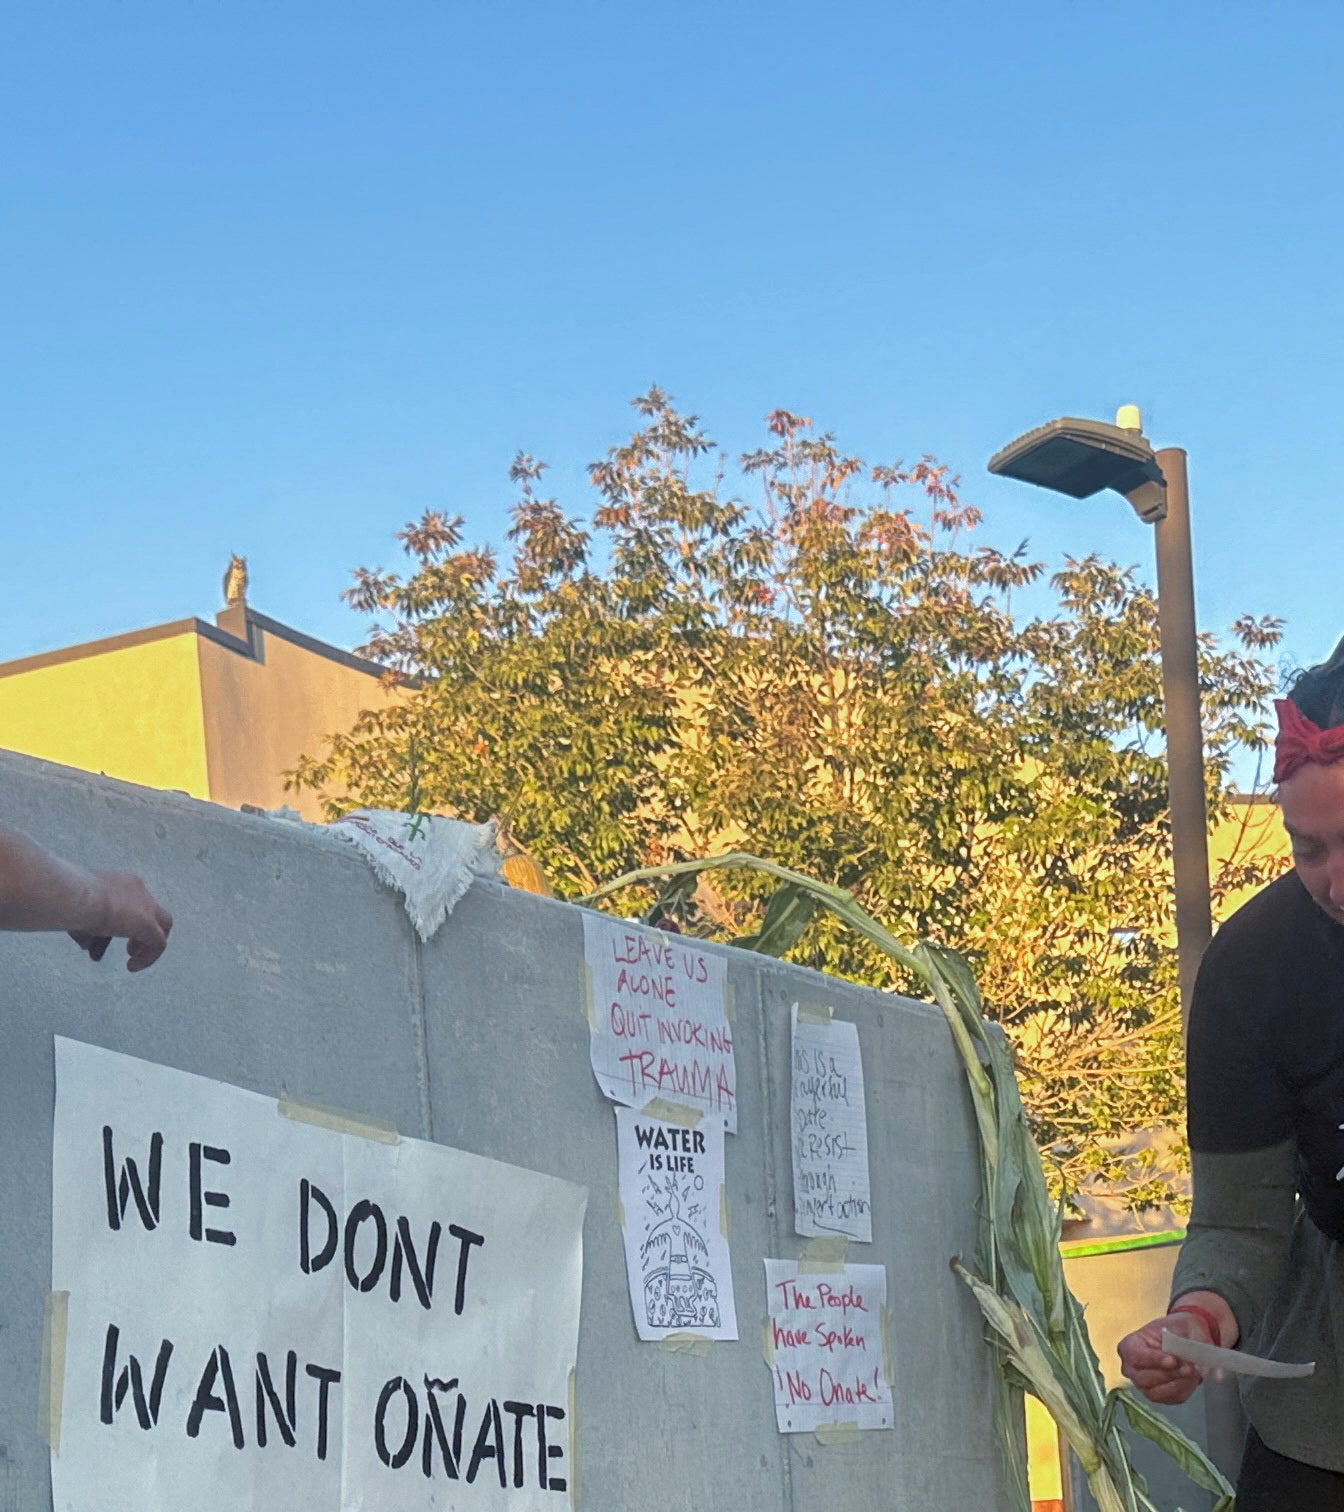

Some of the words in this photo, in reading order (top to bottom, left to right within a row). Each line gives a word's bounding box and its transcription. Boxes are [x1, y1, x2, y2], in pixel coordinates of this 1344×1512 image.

[611, 933, 676, 971] LEAVE
[683, 951, 709, 984] US
[617, 967, 676, 1009] ALONE
[610, 1001, 653, 1043] QUIT
[656, 1018, 733, 1055] INVOKING
[618, 1047, 735, 1113] TRAUMA
[634, 1124, 706, 1155] WATER
[649, 1153, 664, 1171] IS
[666, 1154, 695, 1174] LIFE
[102, 1123, 237, 1247] WE
[299, 1176, 486, 1316] DONT
[774, 1279, 816, 1311] The
[816, 1282, 870, 1317] People
[771, 1317, 812, 1351] have
[99, 1322, 342, 1461] WANT
[374, 1371, 570, 1493] OÑATE
